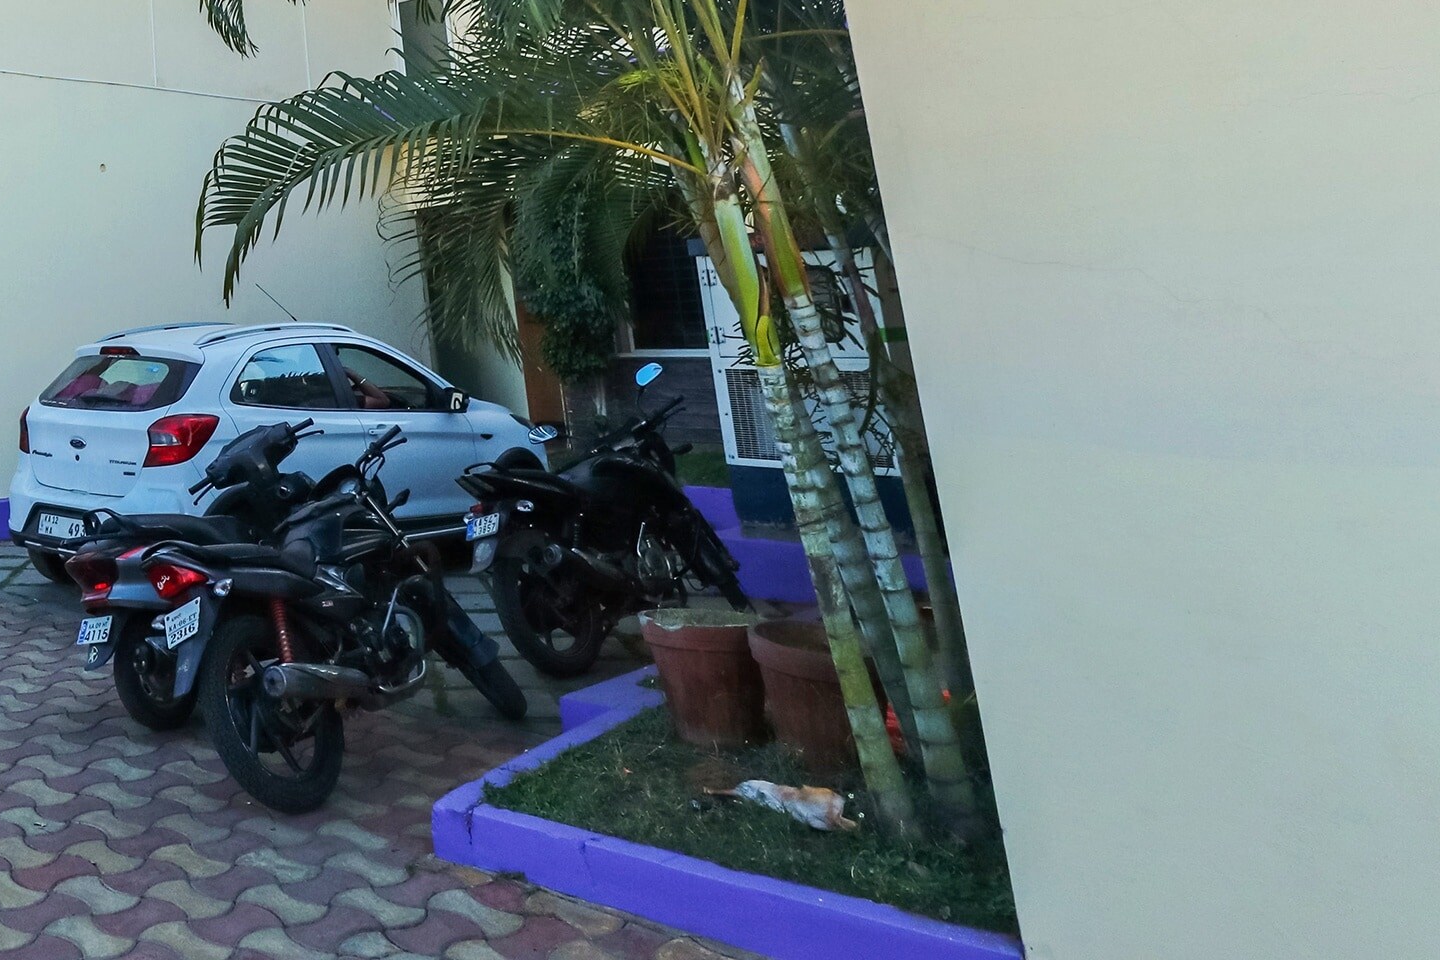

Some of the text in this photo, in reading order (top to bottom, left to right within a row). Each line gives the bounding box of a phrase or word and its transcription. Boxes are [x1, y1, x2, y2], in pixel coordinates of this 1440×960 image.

[68, 522, 87, 537] 493
[84, 628, 108, 641] 4115
[170, 622, 196, 644] 2316
